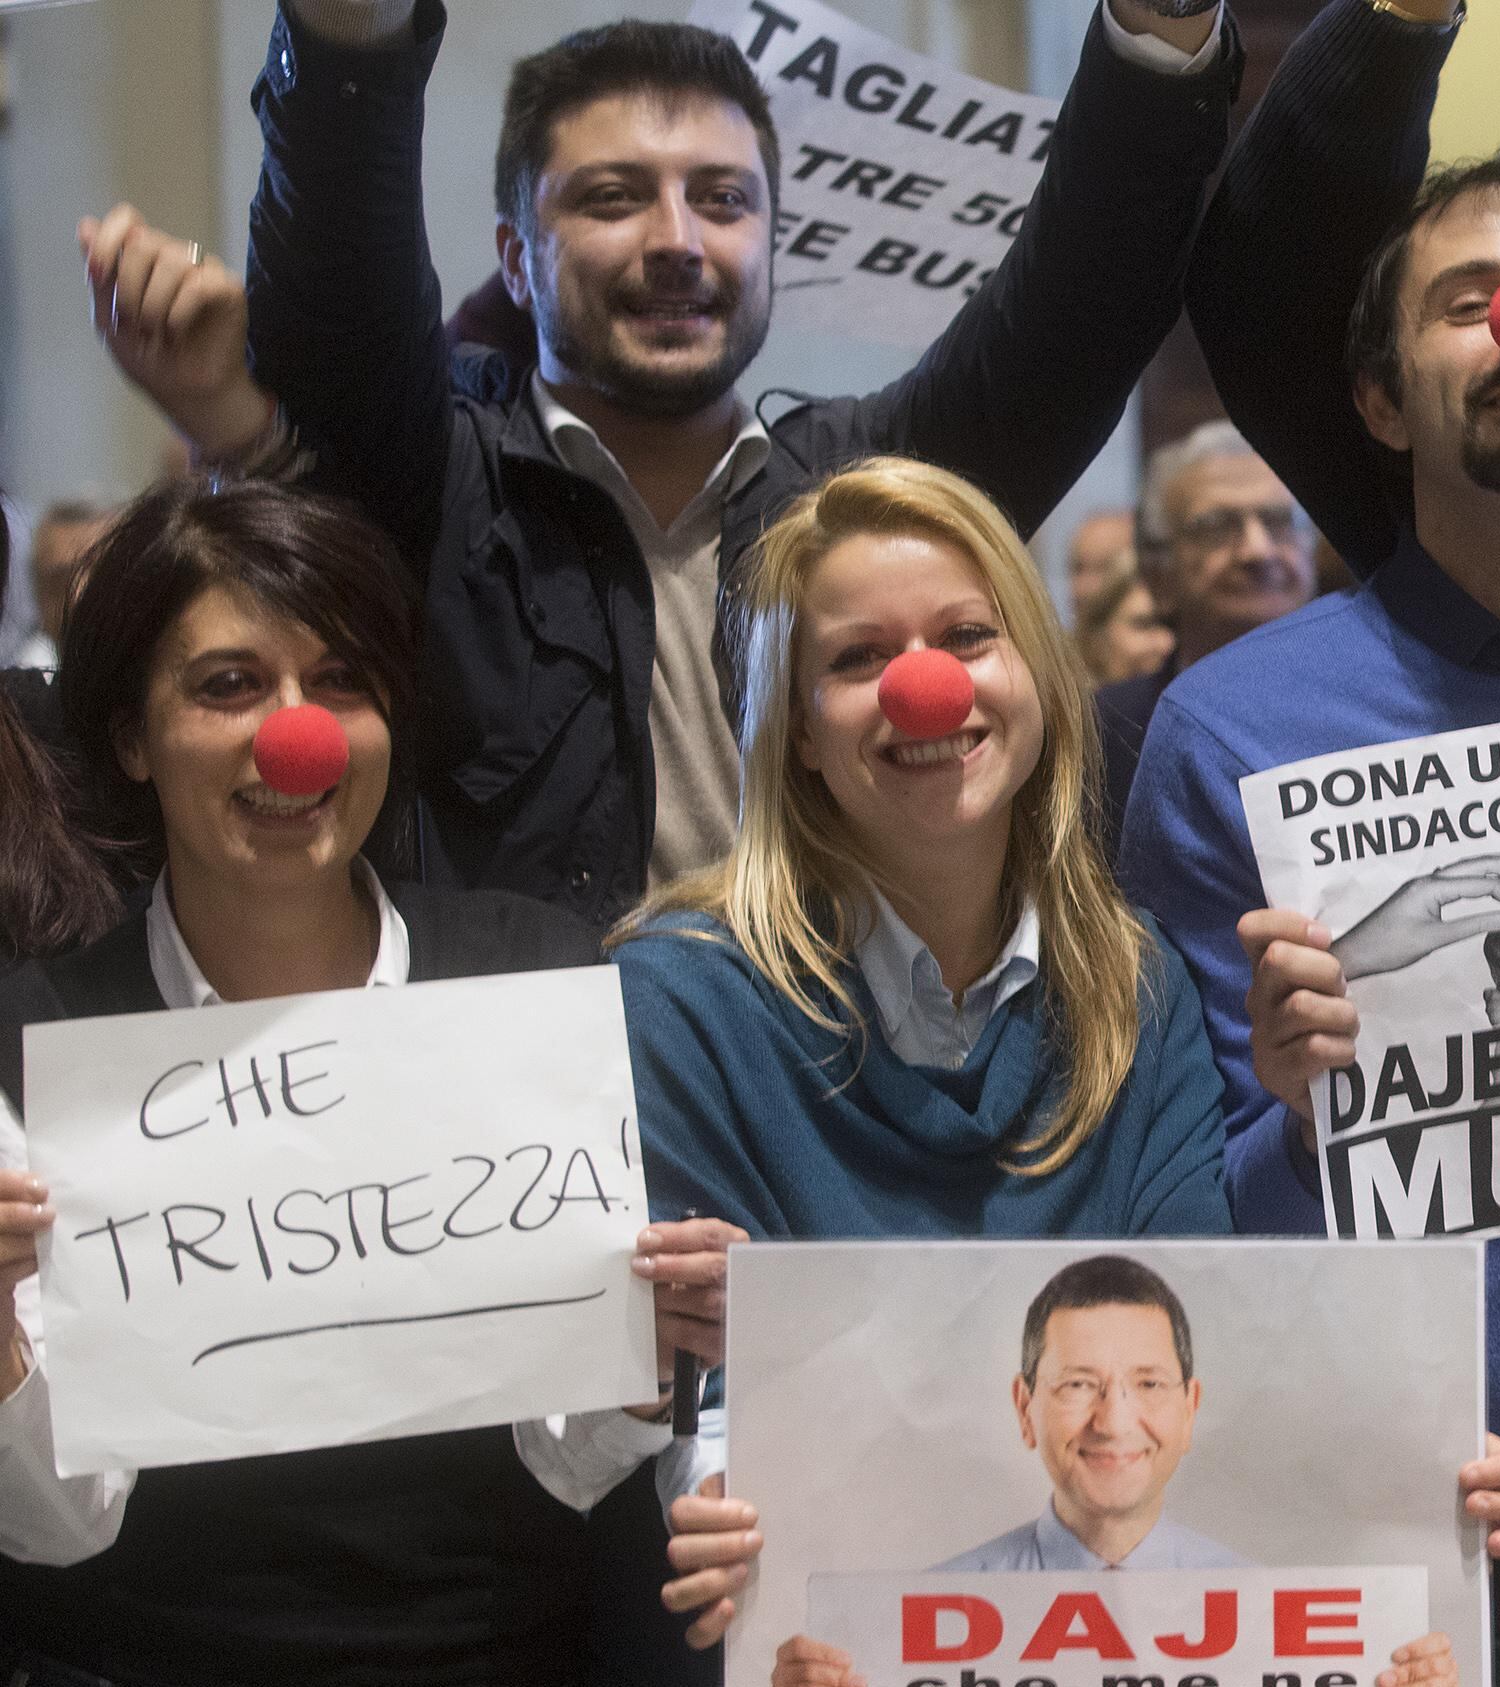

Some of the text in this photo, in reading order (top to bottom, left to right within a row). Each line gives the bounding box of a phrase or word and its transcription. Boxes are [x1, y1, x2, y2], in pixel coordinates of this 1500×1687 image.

[792, 145, 946, 211] TRE
[1279, 752, 1454, 820] DONA
[139, 1040, 346, 1140] CHE
[901, 1588, 1364, 1664] DAJE
